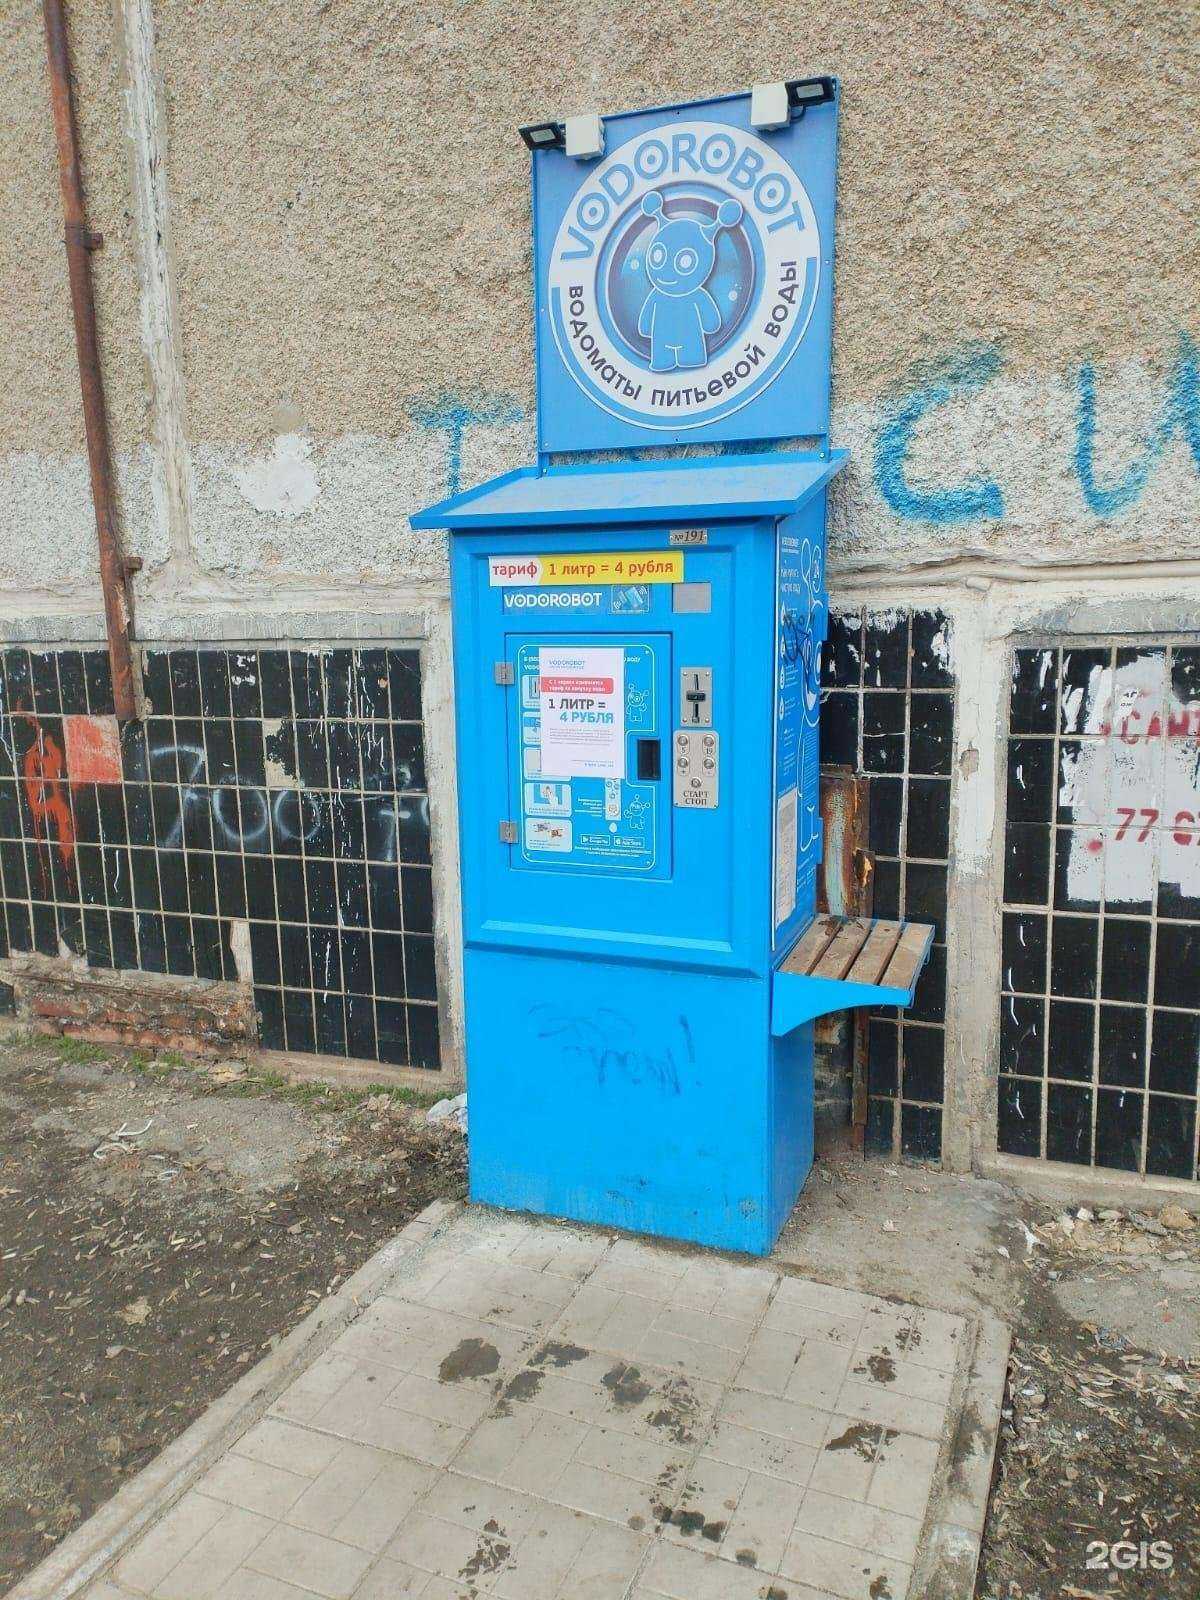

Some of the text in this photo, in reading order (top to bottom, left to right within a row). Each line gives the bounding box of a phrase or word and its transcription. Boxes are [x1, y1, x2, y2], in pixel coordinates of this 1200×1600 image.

[560, 132, 806, 262] VODOROBOT
[763, 259, 800, 339] ВОДЫ
[492, 563, 538, 578] тариф
[549, 563, 556, 576] 1
[562, 563, 596, 579] литр
[614, 561, 623, 574] 4
[628, 560, 674, 578] рубля
[503, 591, 602, 609] VODOROBOT
[549, 698, 556, 709] 1
[560, 698, 595, 710] ЛИТР
[560, 711, 614, 724] 4 РУБЛЯ
[683, 790, 709, 798] СТАРТ
